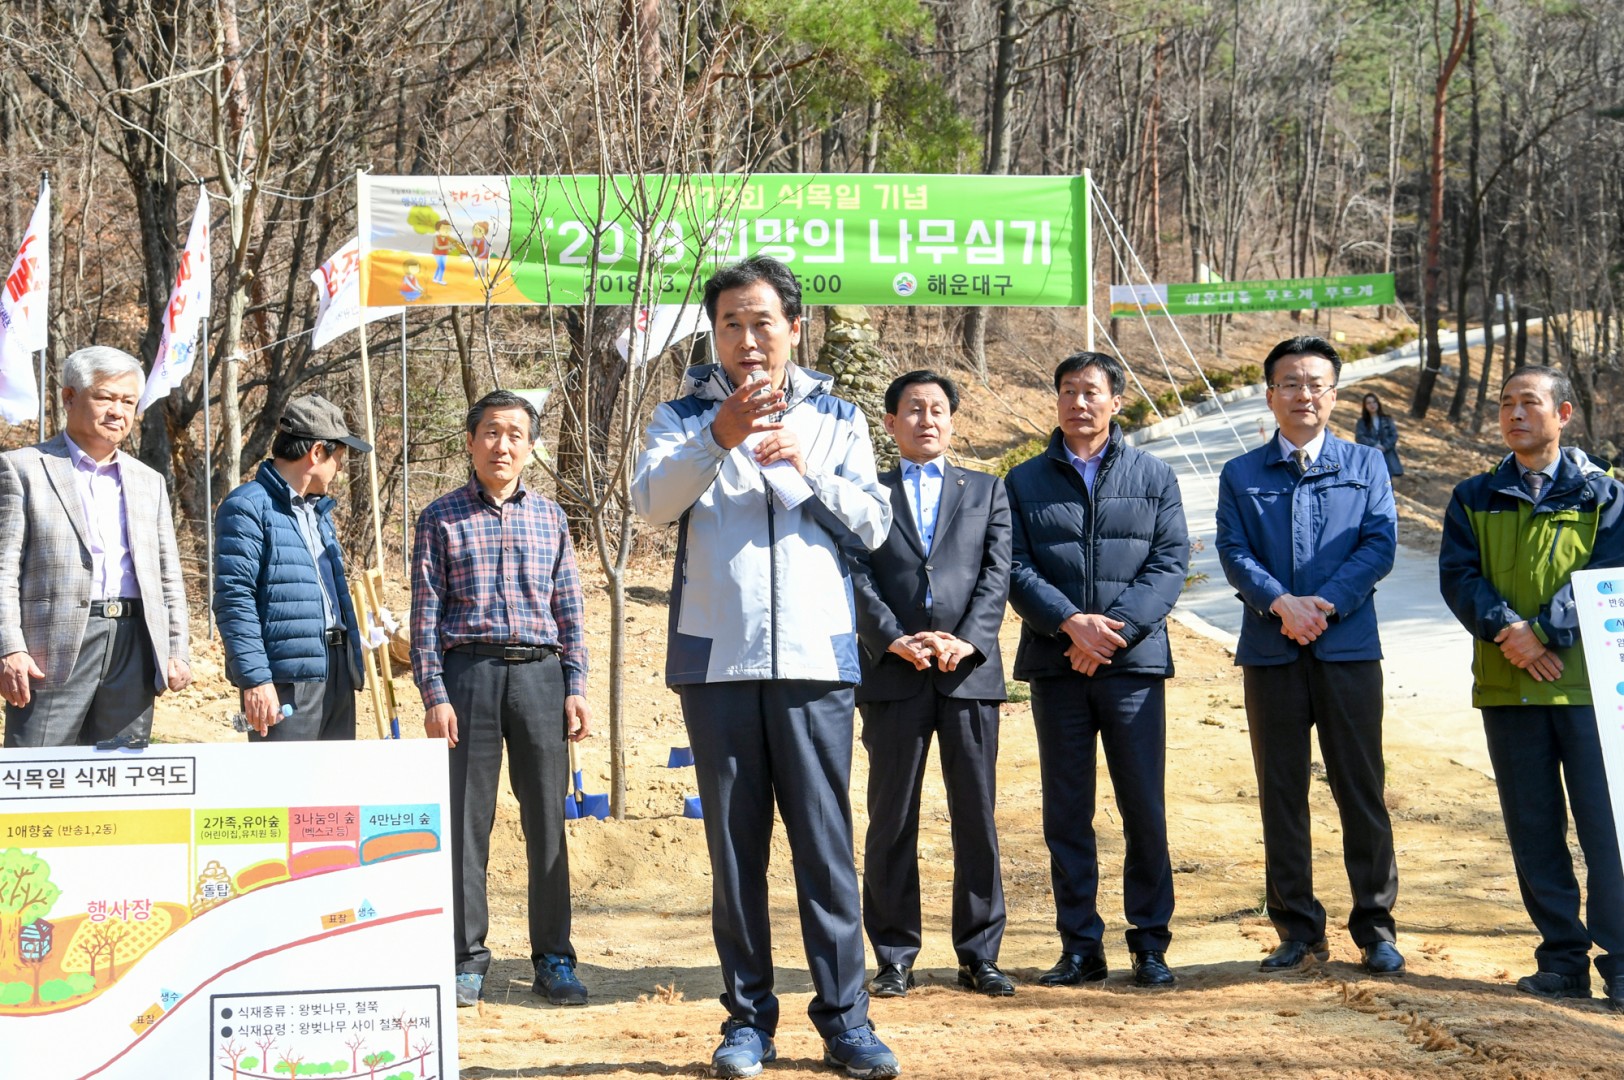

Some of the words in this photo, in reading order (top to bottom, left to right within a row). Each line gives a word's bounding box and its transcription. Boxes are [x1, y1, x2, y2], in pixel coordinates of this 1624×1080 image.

[777, 184, 861, 210] 식목일
[873, 184, 928, 210] 기념
[706, 218, 845, 264] 희망의
[869, 219, 1051, 265] 나무심기
[927, 274, 1013, 296] 해운대구
[2, 767, 67, 790] 식목일
[75, 766, 117, 788] 식재
[125, 765, 188, 786] 구역도
[203, 815, 280, 830] 2가족,유아숲
[294, 812, 339, 825] 3나눔의
[344, 811, 355, 824] 숲
[369, 813, 413, 826] 4만남의
[418, 812, 430, 825] 숲
[7, 824, 54, 838] 1애향숲
[57, 823, 118, 837] (반송1,2동)
[200, 830, 267, 839] (어린이집,유치원
[270, 829, 282, 838] 등)
[336, 826, 349, 836] 등)
[204, 884, 229, 897] 돌탑
[87, 899, 152, 922] 행사장
[357, 907, 376, 918] 생수
[160, 992, 179, 1003] 생수
[238, 1005, 286, 1019] 식재종류
[299, 1003, 351, 1016] 왕벚나무,
[355, 1001, 379, 1014] 철쭉
[238, 1023, 286, 1037] 식재요령
[299, 1021, 347, 1035] 왕벚나무
[351, 1019, 375, 1032] 사이
